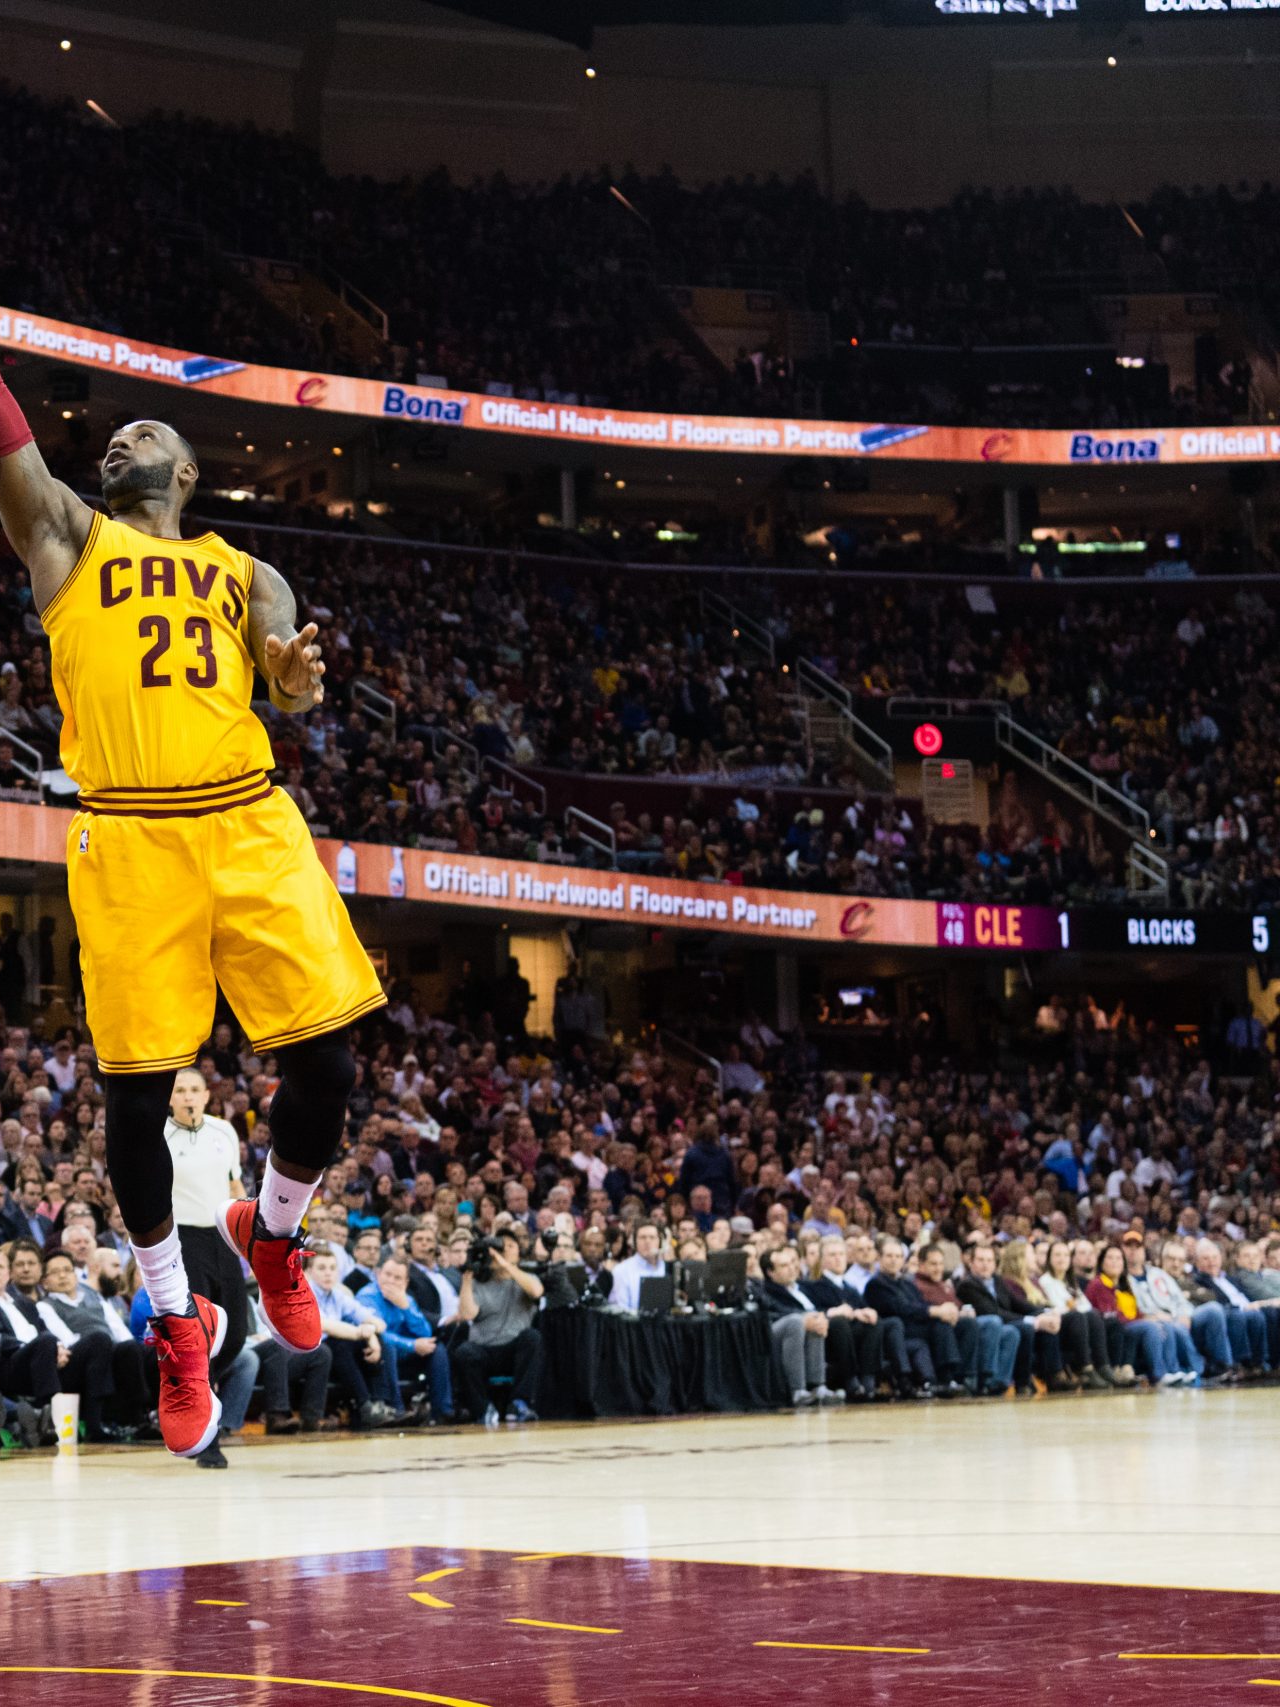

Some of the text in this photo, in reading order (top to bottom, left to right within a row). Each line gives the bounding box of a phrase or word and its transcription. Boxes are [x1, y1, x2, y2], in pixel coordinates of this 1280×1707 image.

[14, 315, 111, 361] Floorcare
[383, 385, 463, 424] Bona
[481, 401, 556, 430] Official
[560, 411, 668, 441] Hardwood
[672, 420, 779, 446] Floorcare
[1070, 432, 1160, 461] Bona
[1180, 432, 1265, 455] Official
[100, 556, 245, 629] CAVS
[139, 615, 217, 688] 23
[425, 863, 816, 929] Official Hardwood Floorcare Partner
[975, 907, 1269, 951] CLE 1 BLOCKS 5
